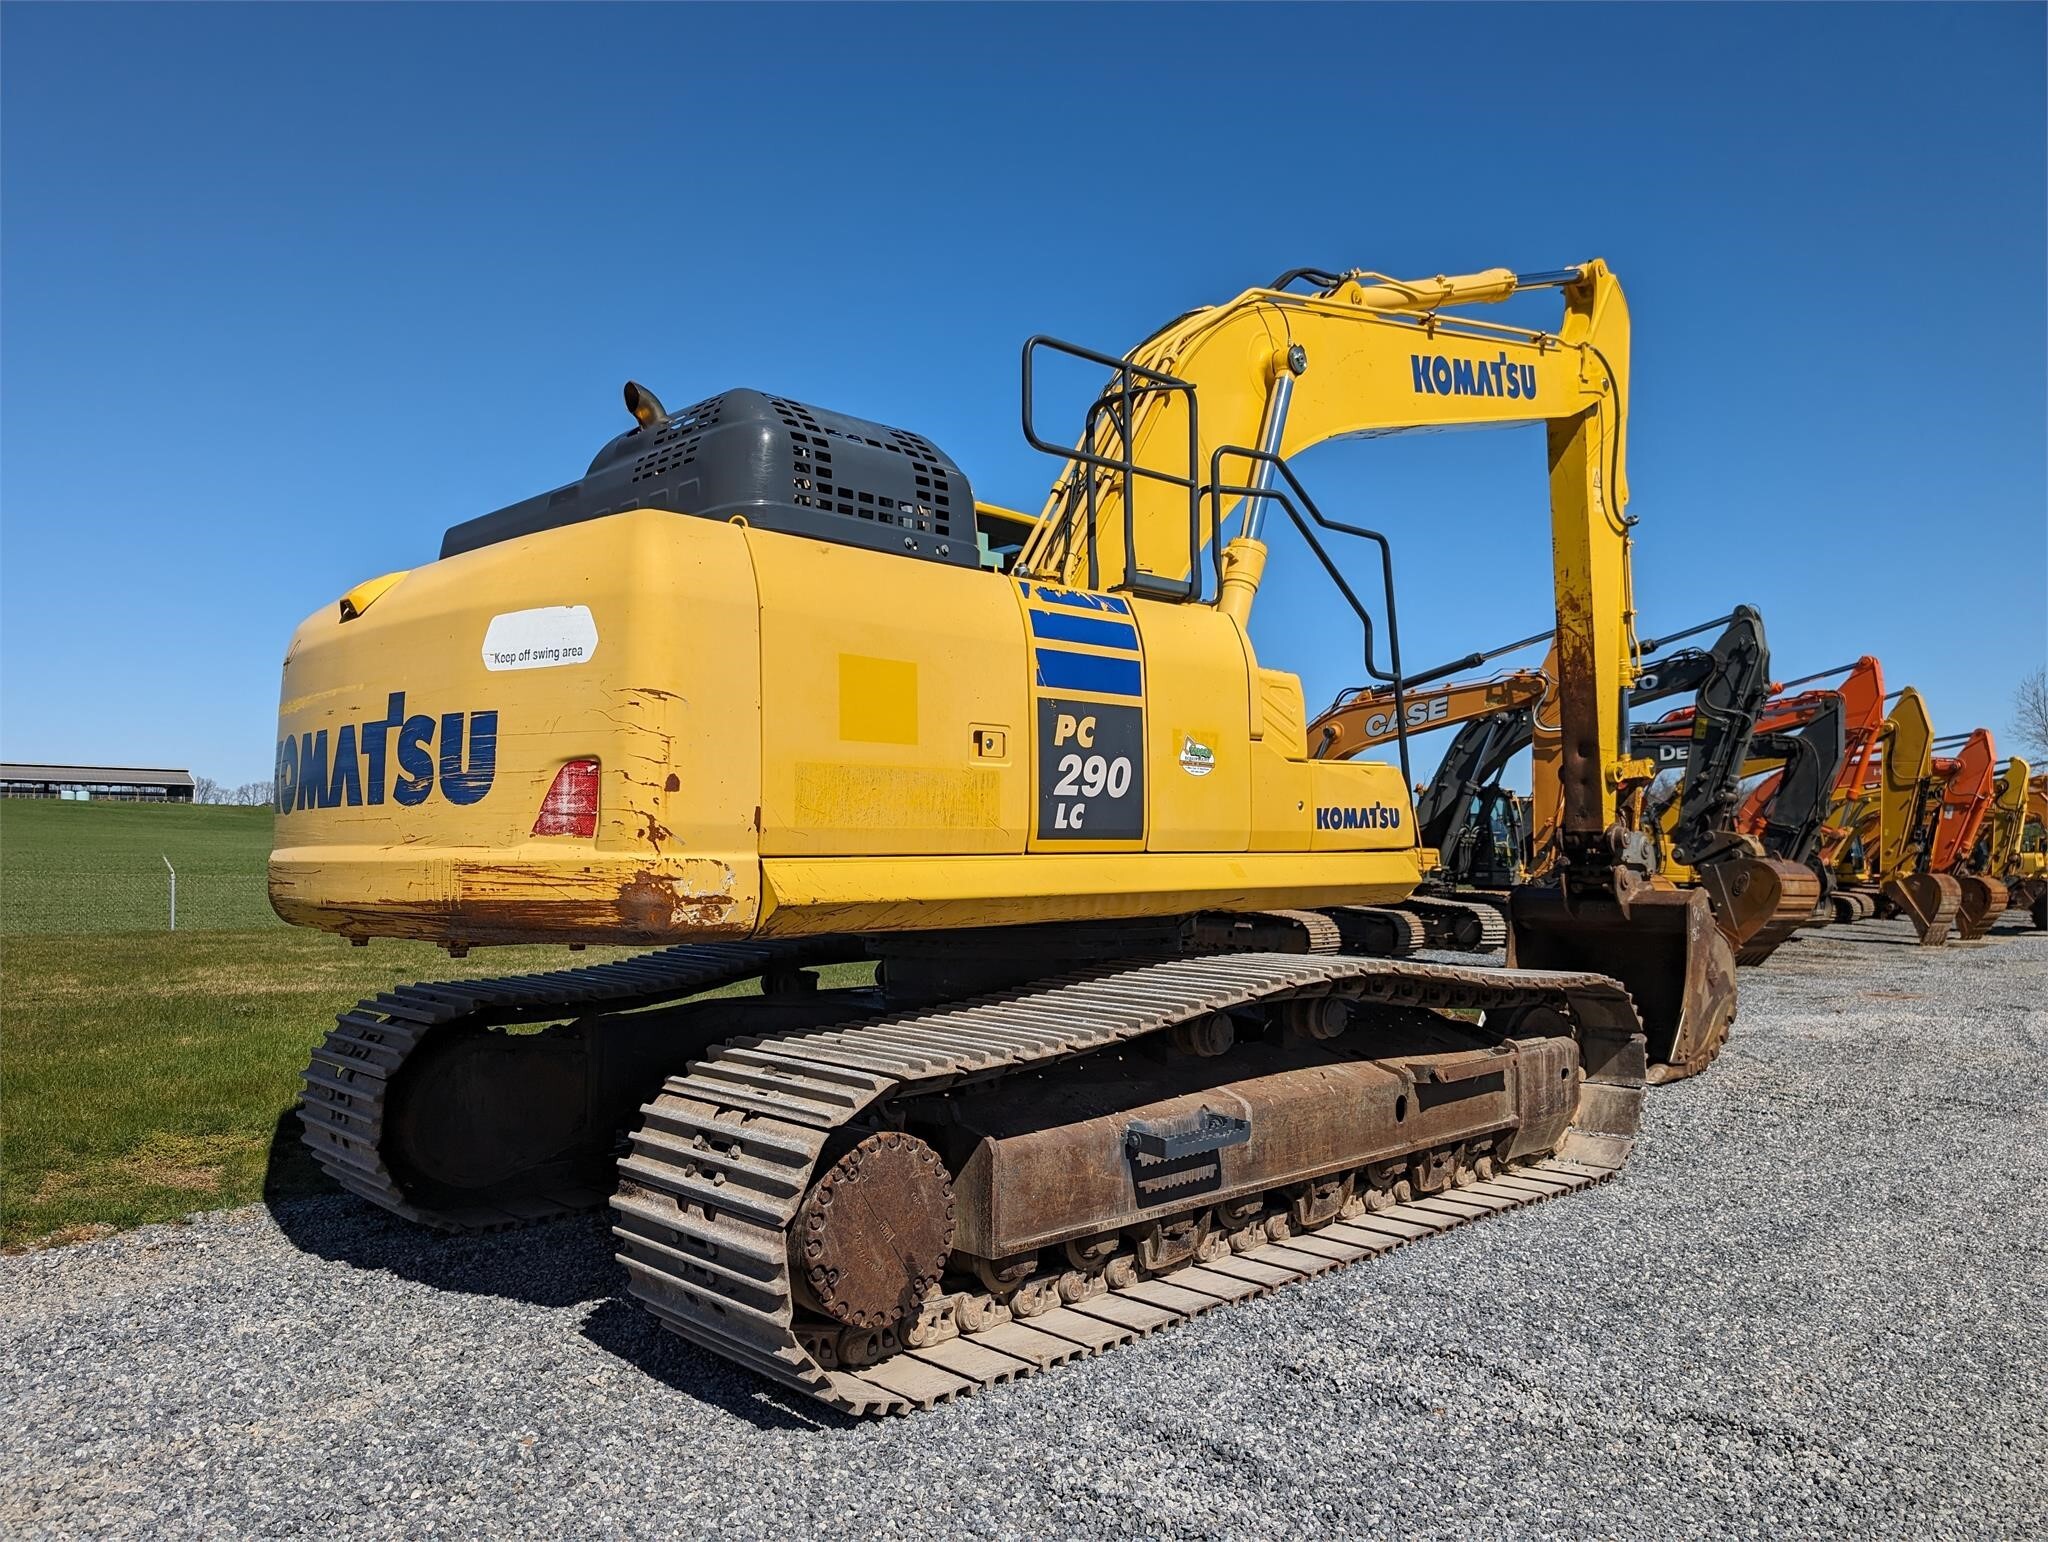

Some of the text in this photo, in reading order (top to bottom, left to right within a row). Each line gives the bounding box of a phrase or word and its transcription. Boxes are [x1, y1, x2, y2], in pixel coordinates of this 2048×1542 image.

[1410, 351, 1537, 400] KOMATSU
[494, 646, 583, 665] Keep off swing area
[1053, 714, 1097, 748] PC
[1365, 695, 1449, 737] CASE
[273, 691, 499, 815] OMATSU
[1053, 753, 1132, 798] 290
[1054, 803, 1086, 829] LC
[1316, 801, 1400, 830] KOMATSU
